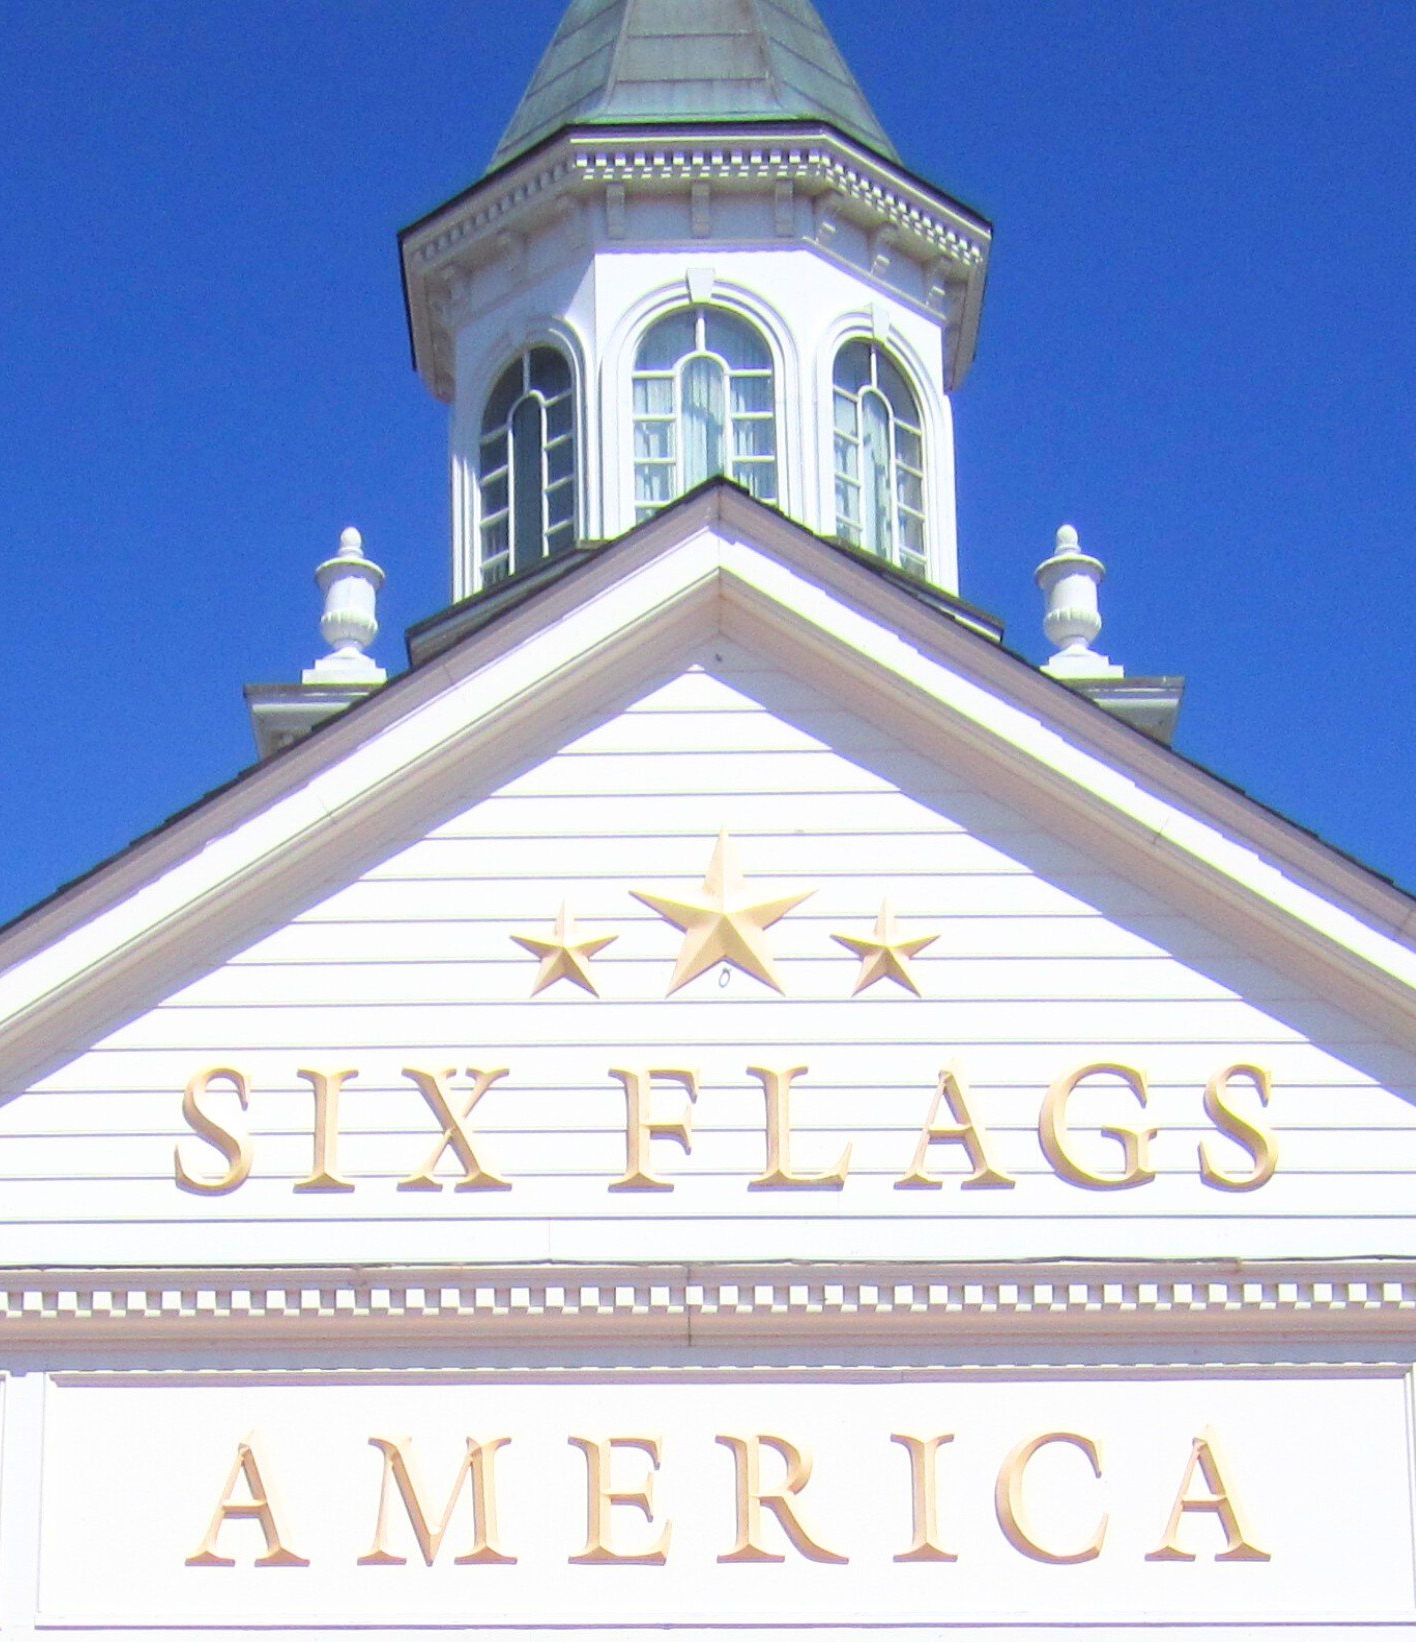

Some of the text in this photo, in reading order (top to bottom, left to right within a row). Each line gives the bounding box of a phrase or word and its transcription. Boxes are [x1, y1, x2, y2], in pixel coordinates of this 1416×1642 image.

[174, 1060, 1278, 1195] SIX FLAGS
[184, 1431, 1271, 1568] AMERICA
